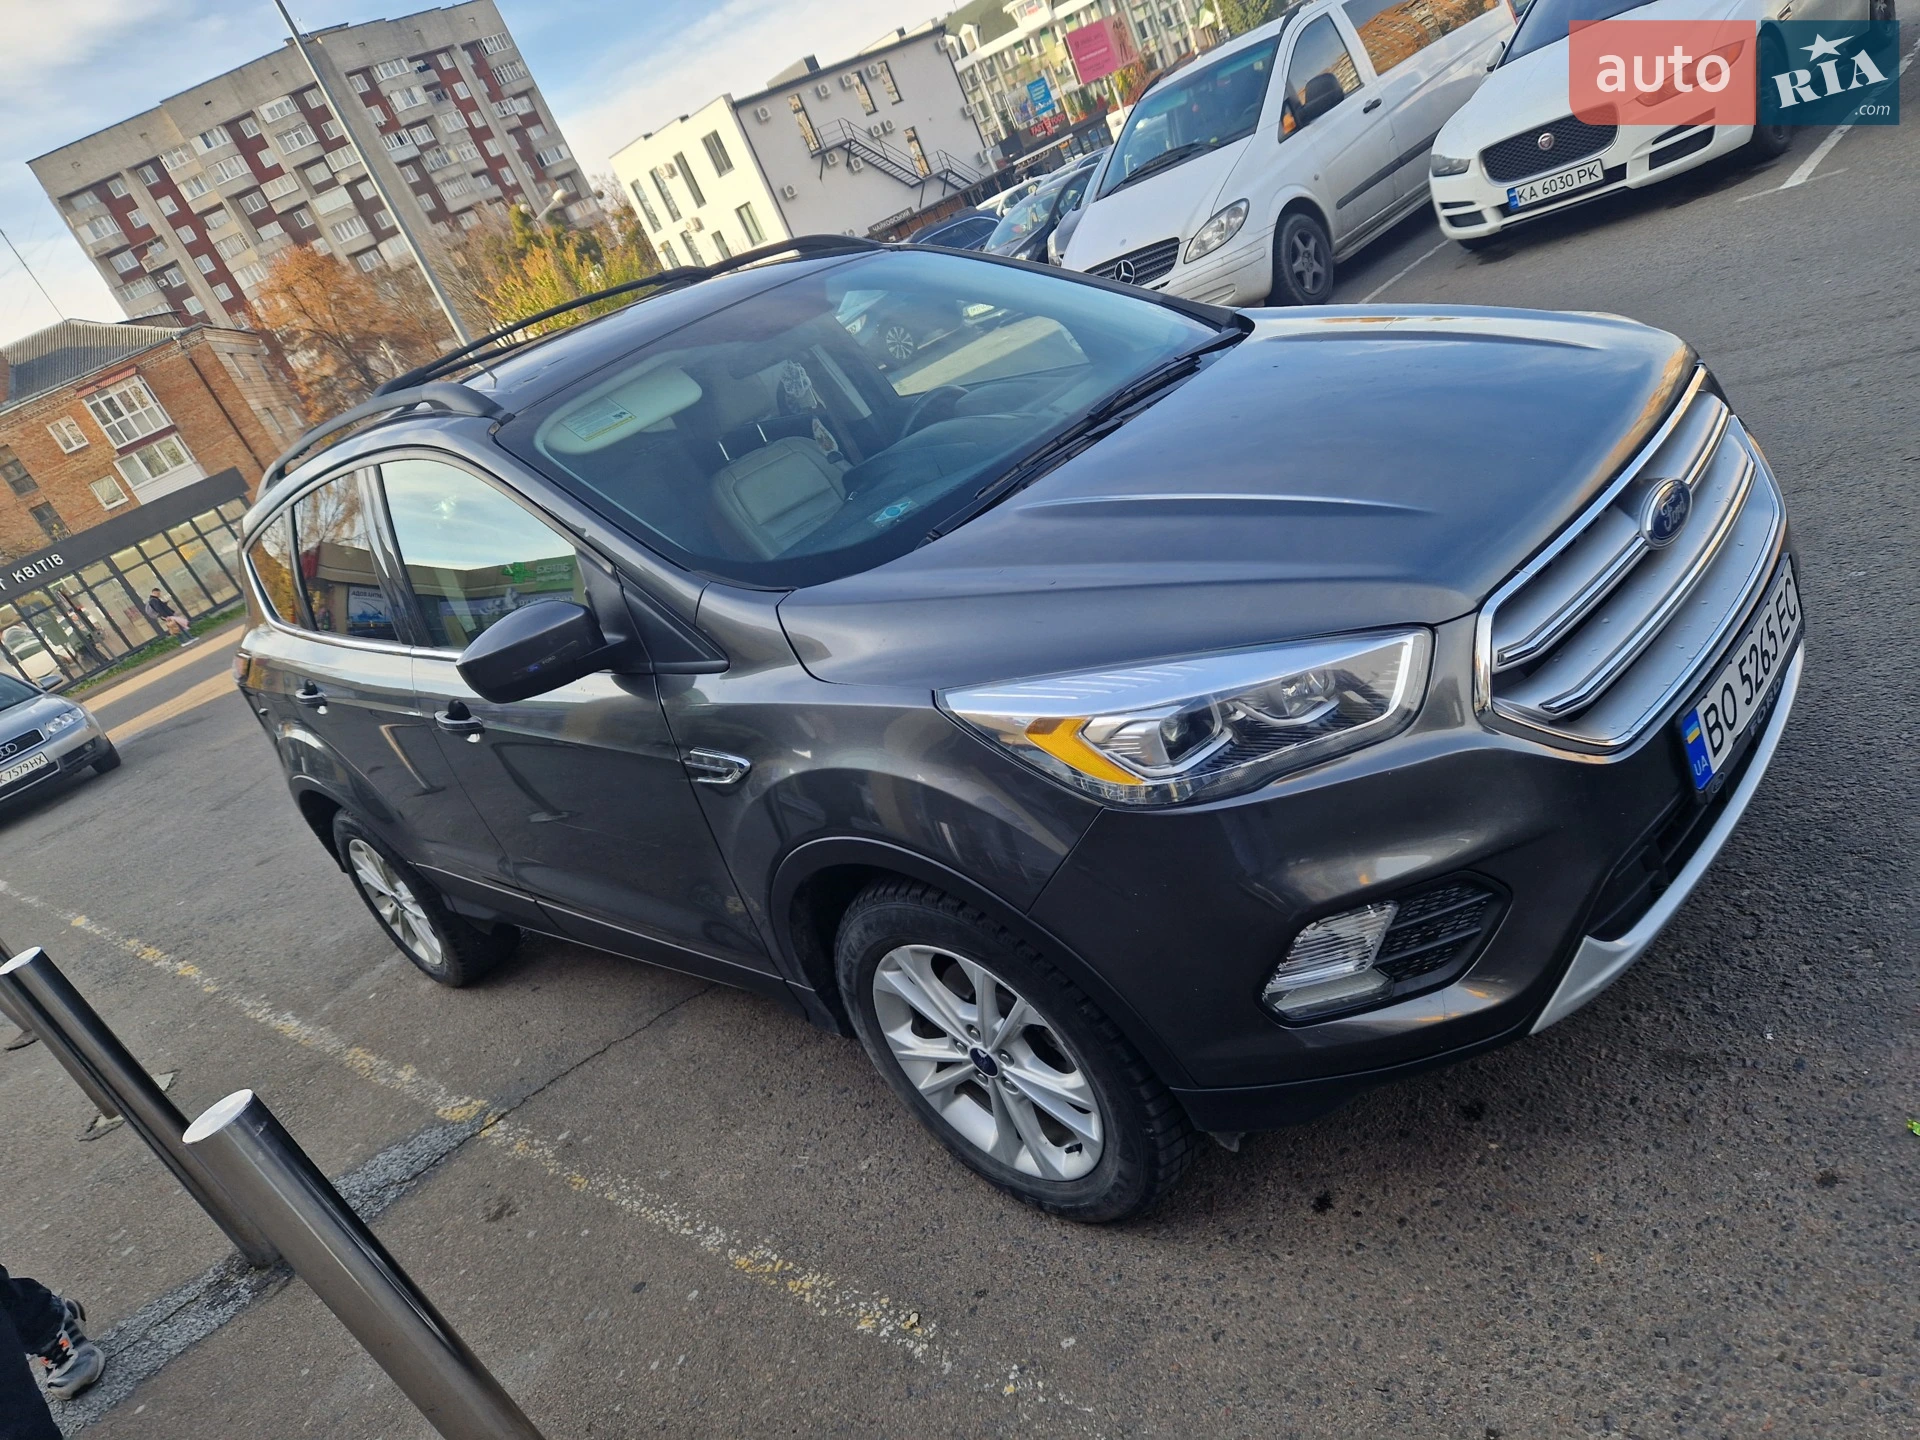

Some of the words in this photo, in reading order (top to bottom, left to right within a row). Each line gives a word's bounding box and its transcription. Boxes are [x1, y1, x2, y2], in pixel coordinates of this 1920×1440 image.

[1516, 186, 1539, 203] KA
[1542, 173, 1574, 195] 6030
[1577, 164, 1599, 184] PK
[1661, 493, 1686, 531] Ford
[12, 554, 64, 584] КВІТІВ
[1703, 682, 1737, 758] BO
[1738, 613, 1777, 706] 5265
[1775, 577, 1796, 644] EC
[1749, 677, 1782, 737] FORD
[1693, 755, 1709, 776] UA
